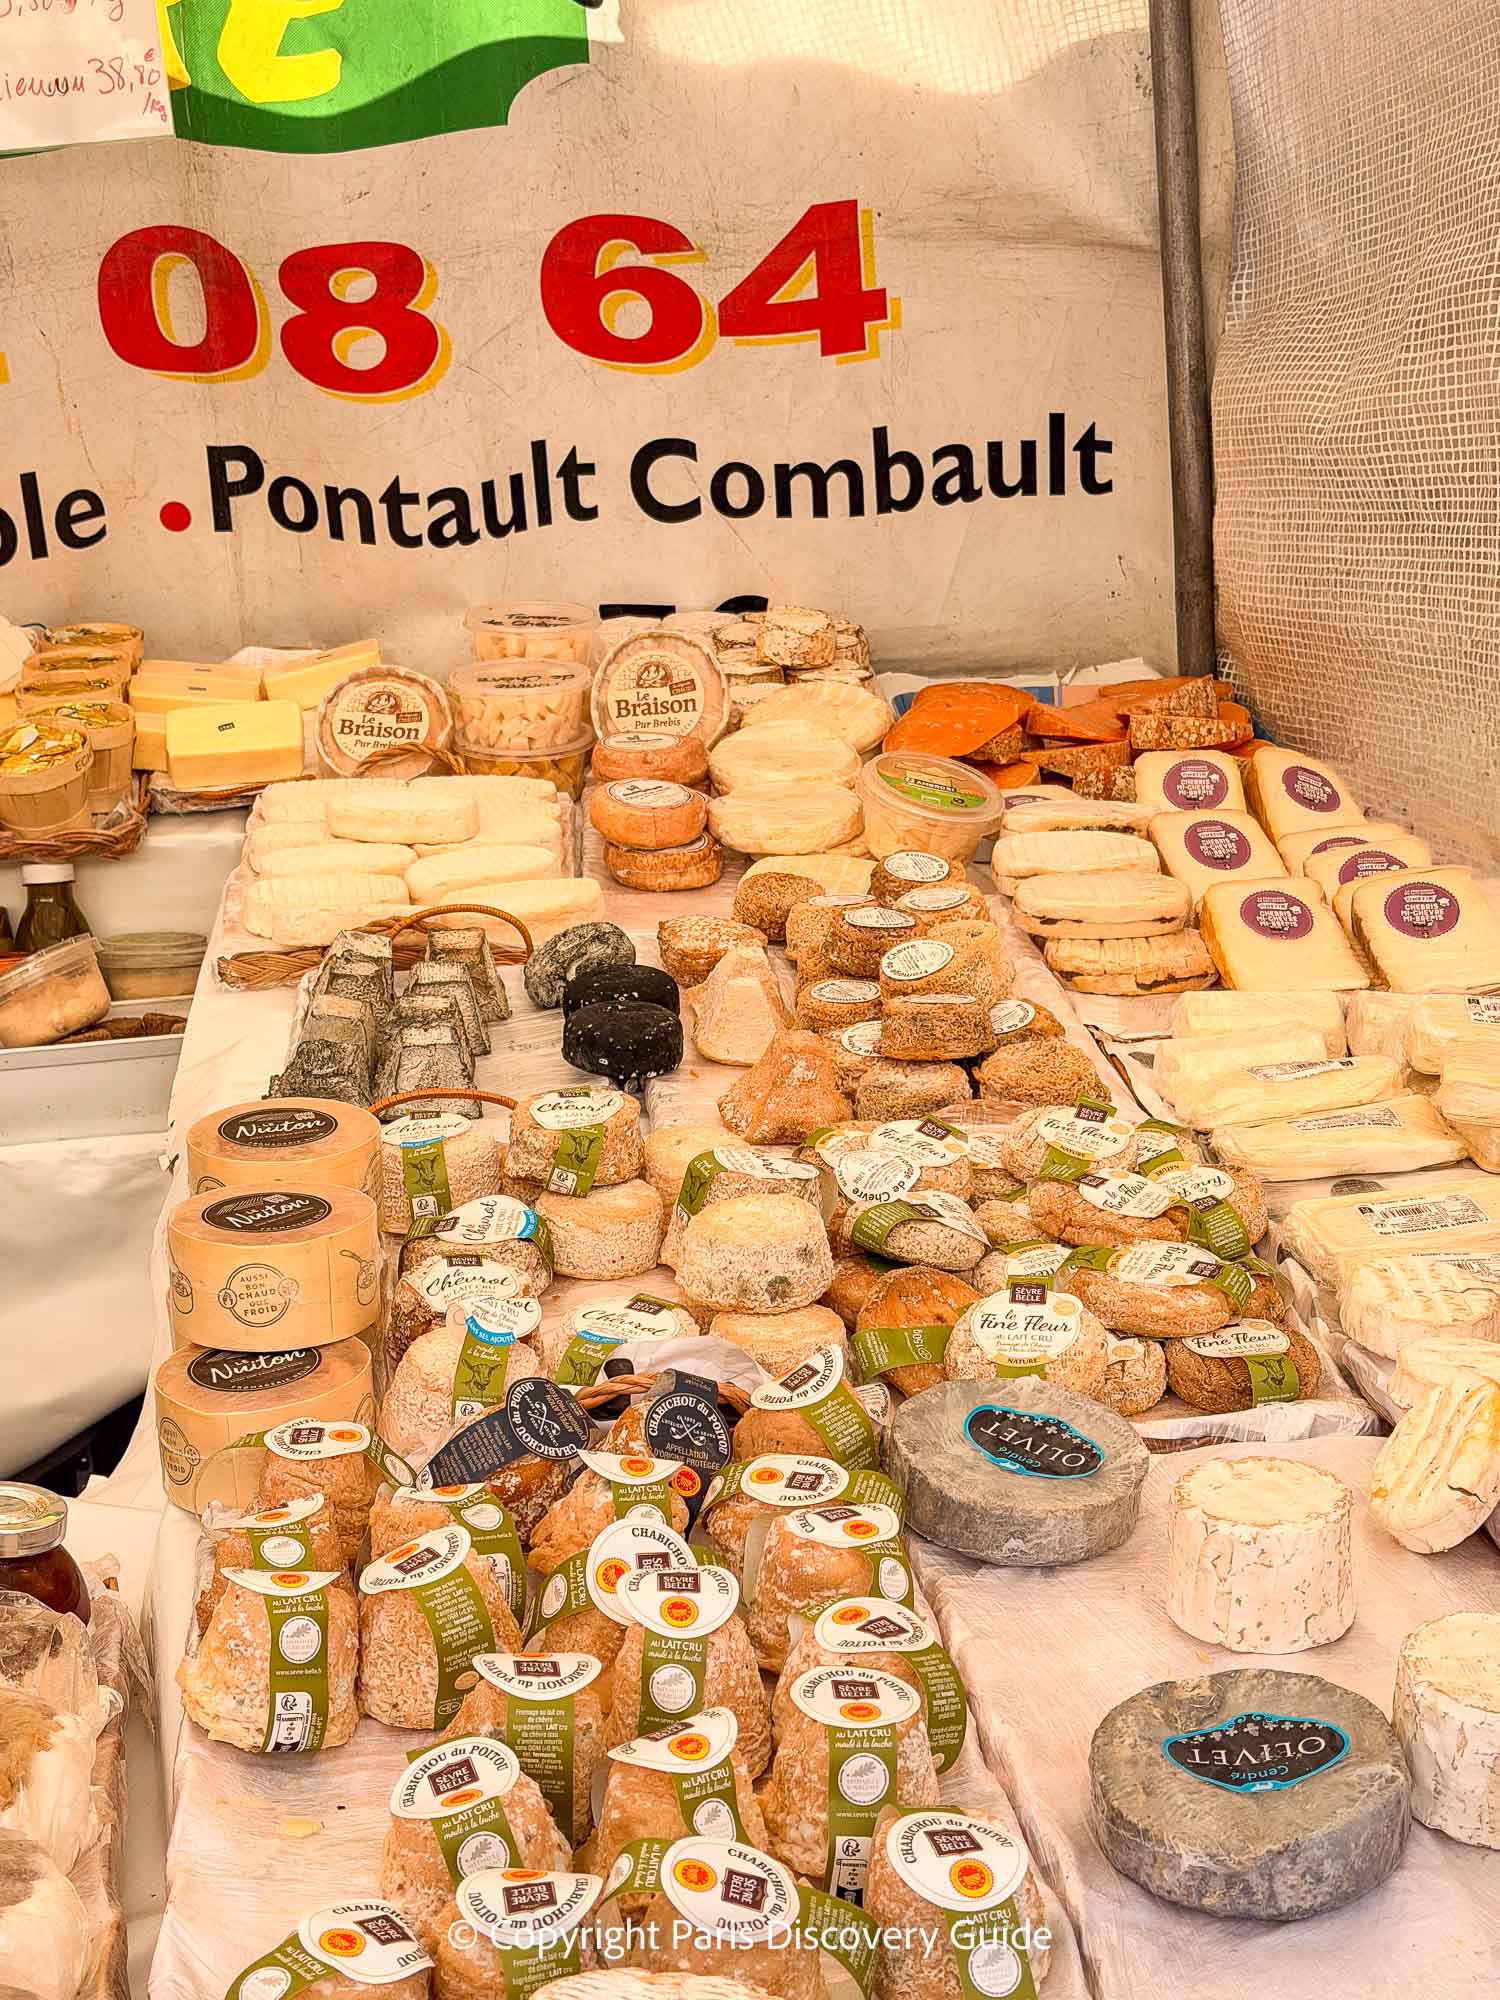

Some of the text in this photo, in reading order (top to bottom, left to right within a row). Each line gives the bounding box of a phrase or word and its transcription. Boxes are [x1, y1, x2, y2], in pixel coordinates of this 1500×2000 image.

[540, 199, 901, 375] 64
[206, 438, 598, 550] Pontault
[630, 412, 1114, 524] Combault
[636, 691, 650, 701] Le
[615, 697, 698, 719] Braison
[361, 714, 375, 724] Le
[634, 717, 681, 729] Pur Brebis
[338, 719, 420, 740] Braison
[1044, 1118, 1120, 1145] Fine Fleur
[240, 1273, 269, 1283] AUSSI
[245, 1282, 266, 1290] BON
[238, 1289, 277, 1300] CHAUD
[1016, 1287, 1043, 1295] SÈVRE
[243, 1305, 279, 1317] FROID
[1005, 1309, 1017, 1320] le
[980, 1313, 1072, 1332] Fine Fleur
[1031, 1334, 1052, 1342] CRU
[1191, 1332, 1281, 1348] Fine Fleur
[796, 1390, 809, 1398] du
[510, 1382, 577, 1457] CHABICHOU du POITOU
[648, 1396, 728, 1455] CHABICHOU du POITOU
[665, 1442, 709, 1460] APPELLATION
[980, 1421, 1086, 1467] OLIVET
[628, 1484, 664, 1494] LAIT CRU
[631, 1527, 693, 1566] CHABICHO
[663, 1582, 695, 1590] BELLE
[701, 1568, 730, 1596] POITOU
[282, 1597, 301, 1606] LAIT
[302, 1594, 323, 1604] CRU
[661, 1639, 681, 1650] LAIT
[682, 1641, 703, 1652] CRU
[517, 1680, 534, 1691] du
[803, 1669, 854, 1700] CHABICHOU
[858, 1671, 874, 1680] du
[838, 1684, 872, 1692] SÈVRE
[847, 1728, 868, 1738] LAIT
[869, 1728, 892, 1737] CRU
[870, 1739, 893, 1748] louche
[1187, 1736, 1326, 1766] OLIVET
[402, 1745, 511, 1808] CHABICHOU du POITOU
[435, 1766, 471, 1785] SÈVRE
[439, 1776, 473, 1792] BELLE
[692, 1774, 710, 1786] LAIT
[711, 1767, 730, 1781] CRU
[441, 1801, 497, 1830] AU LAIT CRU
[479, 1811, 502, 1829] louche
[899, 1818, 1014, 1864] CHABICHOU du POITOU
[933, 1833, 969, 1844] SÈVRE
[939, 1841, 975, 1852] BELLE
[511, 1885, 548, 1896] BELLE
[727, 1848, 788, 1904] CHABICHOU
[769, 1902, 785, 1916] du
[730, 1874, 742, 1900] BELLE
[511, 1893, 550, 1906] SÈVRE
[740, 1878, 758, 1905] SÈVRE
[509, 1877, 590, 1930] CHABICHOU du
[989, 1908, 1013, 1921] CRU
[364, 1921, 390, 1942] BELLE
[376, 1918, 401, 1940] SÈVRE
[292, 1949, 327, 1976] LAIT CRU
[549, 1968, 563, 1977] LAIT
